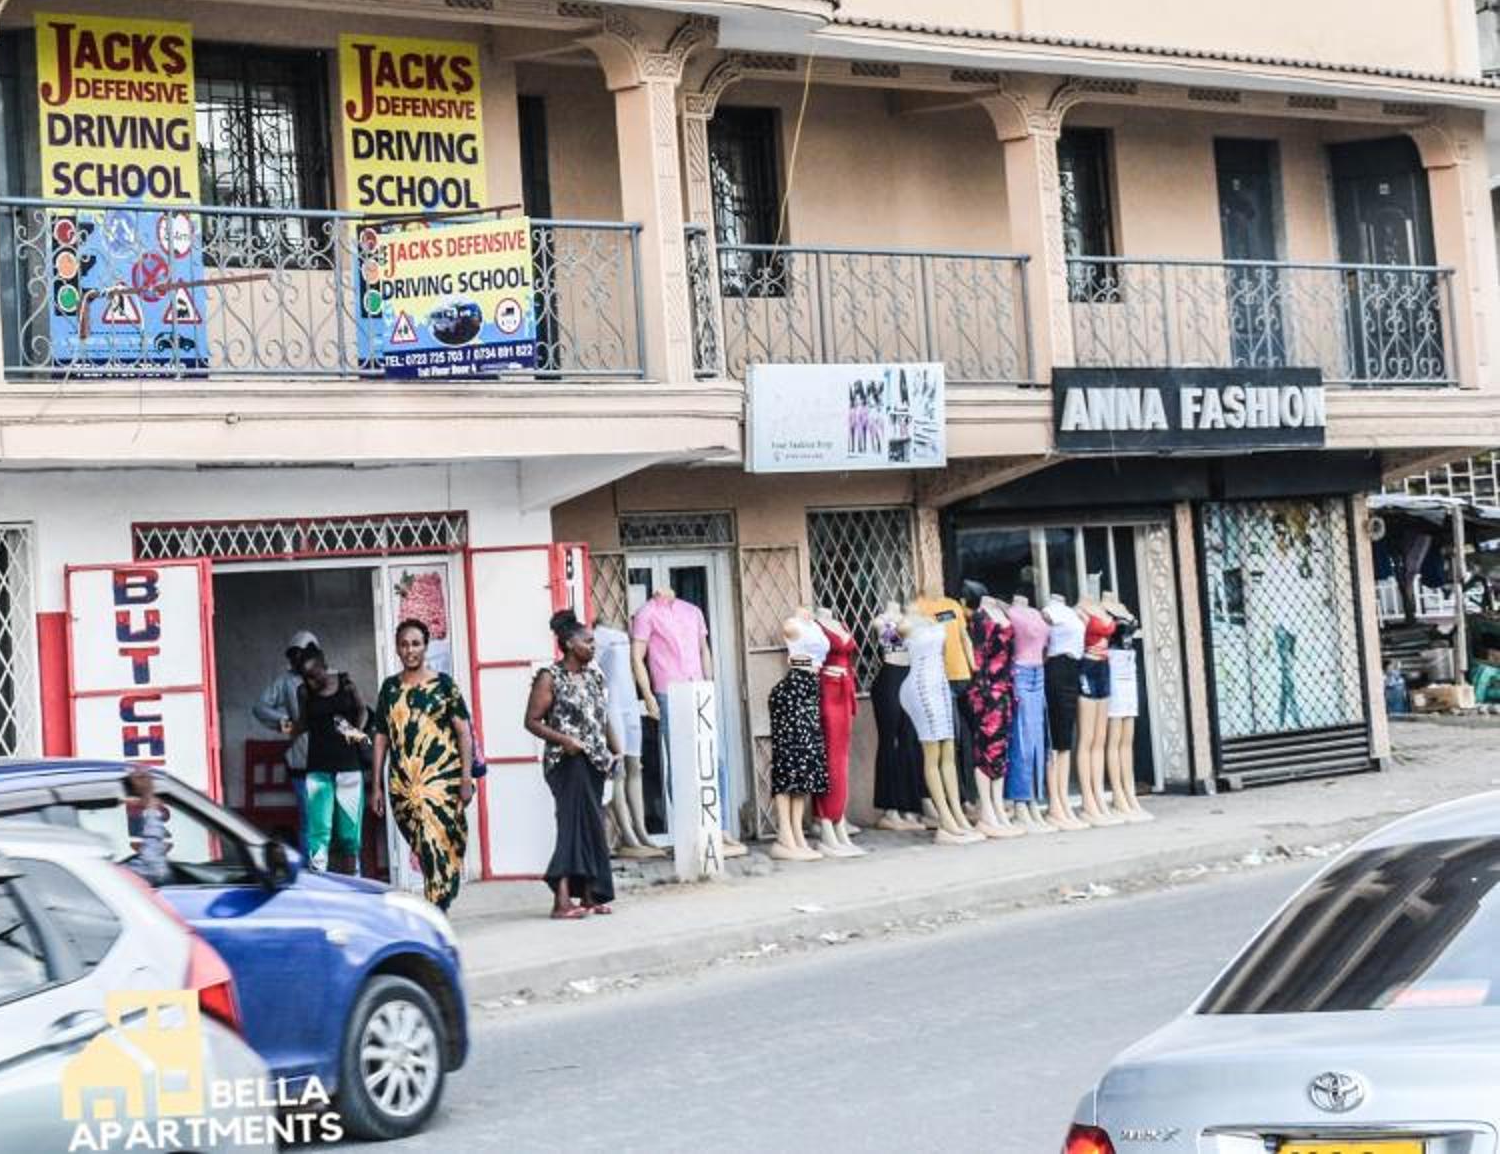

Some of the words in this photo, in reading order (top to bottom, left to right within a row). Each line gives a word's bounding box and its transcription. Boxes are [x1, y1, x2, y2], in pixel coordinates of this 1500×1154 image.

[41, 22, 187, 106] JACKS
[346, 44, 474, 122] JACKS
[75, 77, 189, 105] DEFENSIVE
[376, 96, 476, 120] DEFENSIVE
[48, 113, 191, 152] DRIVING
[352, 128, 479, 165] DRIVING
[53, 162, 191, 199] SCHOOL
[358, 174, 480, 209] SCHOOL
[384, 239, 443, 278] JACKS
[446, 230, 526, 257] DEFENSIVE
[382, 274, 453, 301] DRIVING
[458, 266, 530, 293] SCHOOL
[1060, 387, 1169, 431] ANNA
[1180, 385, 1327, 429] FASHION
[697, 691, 719, 873] KURA
